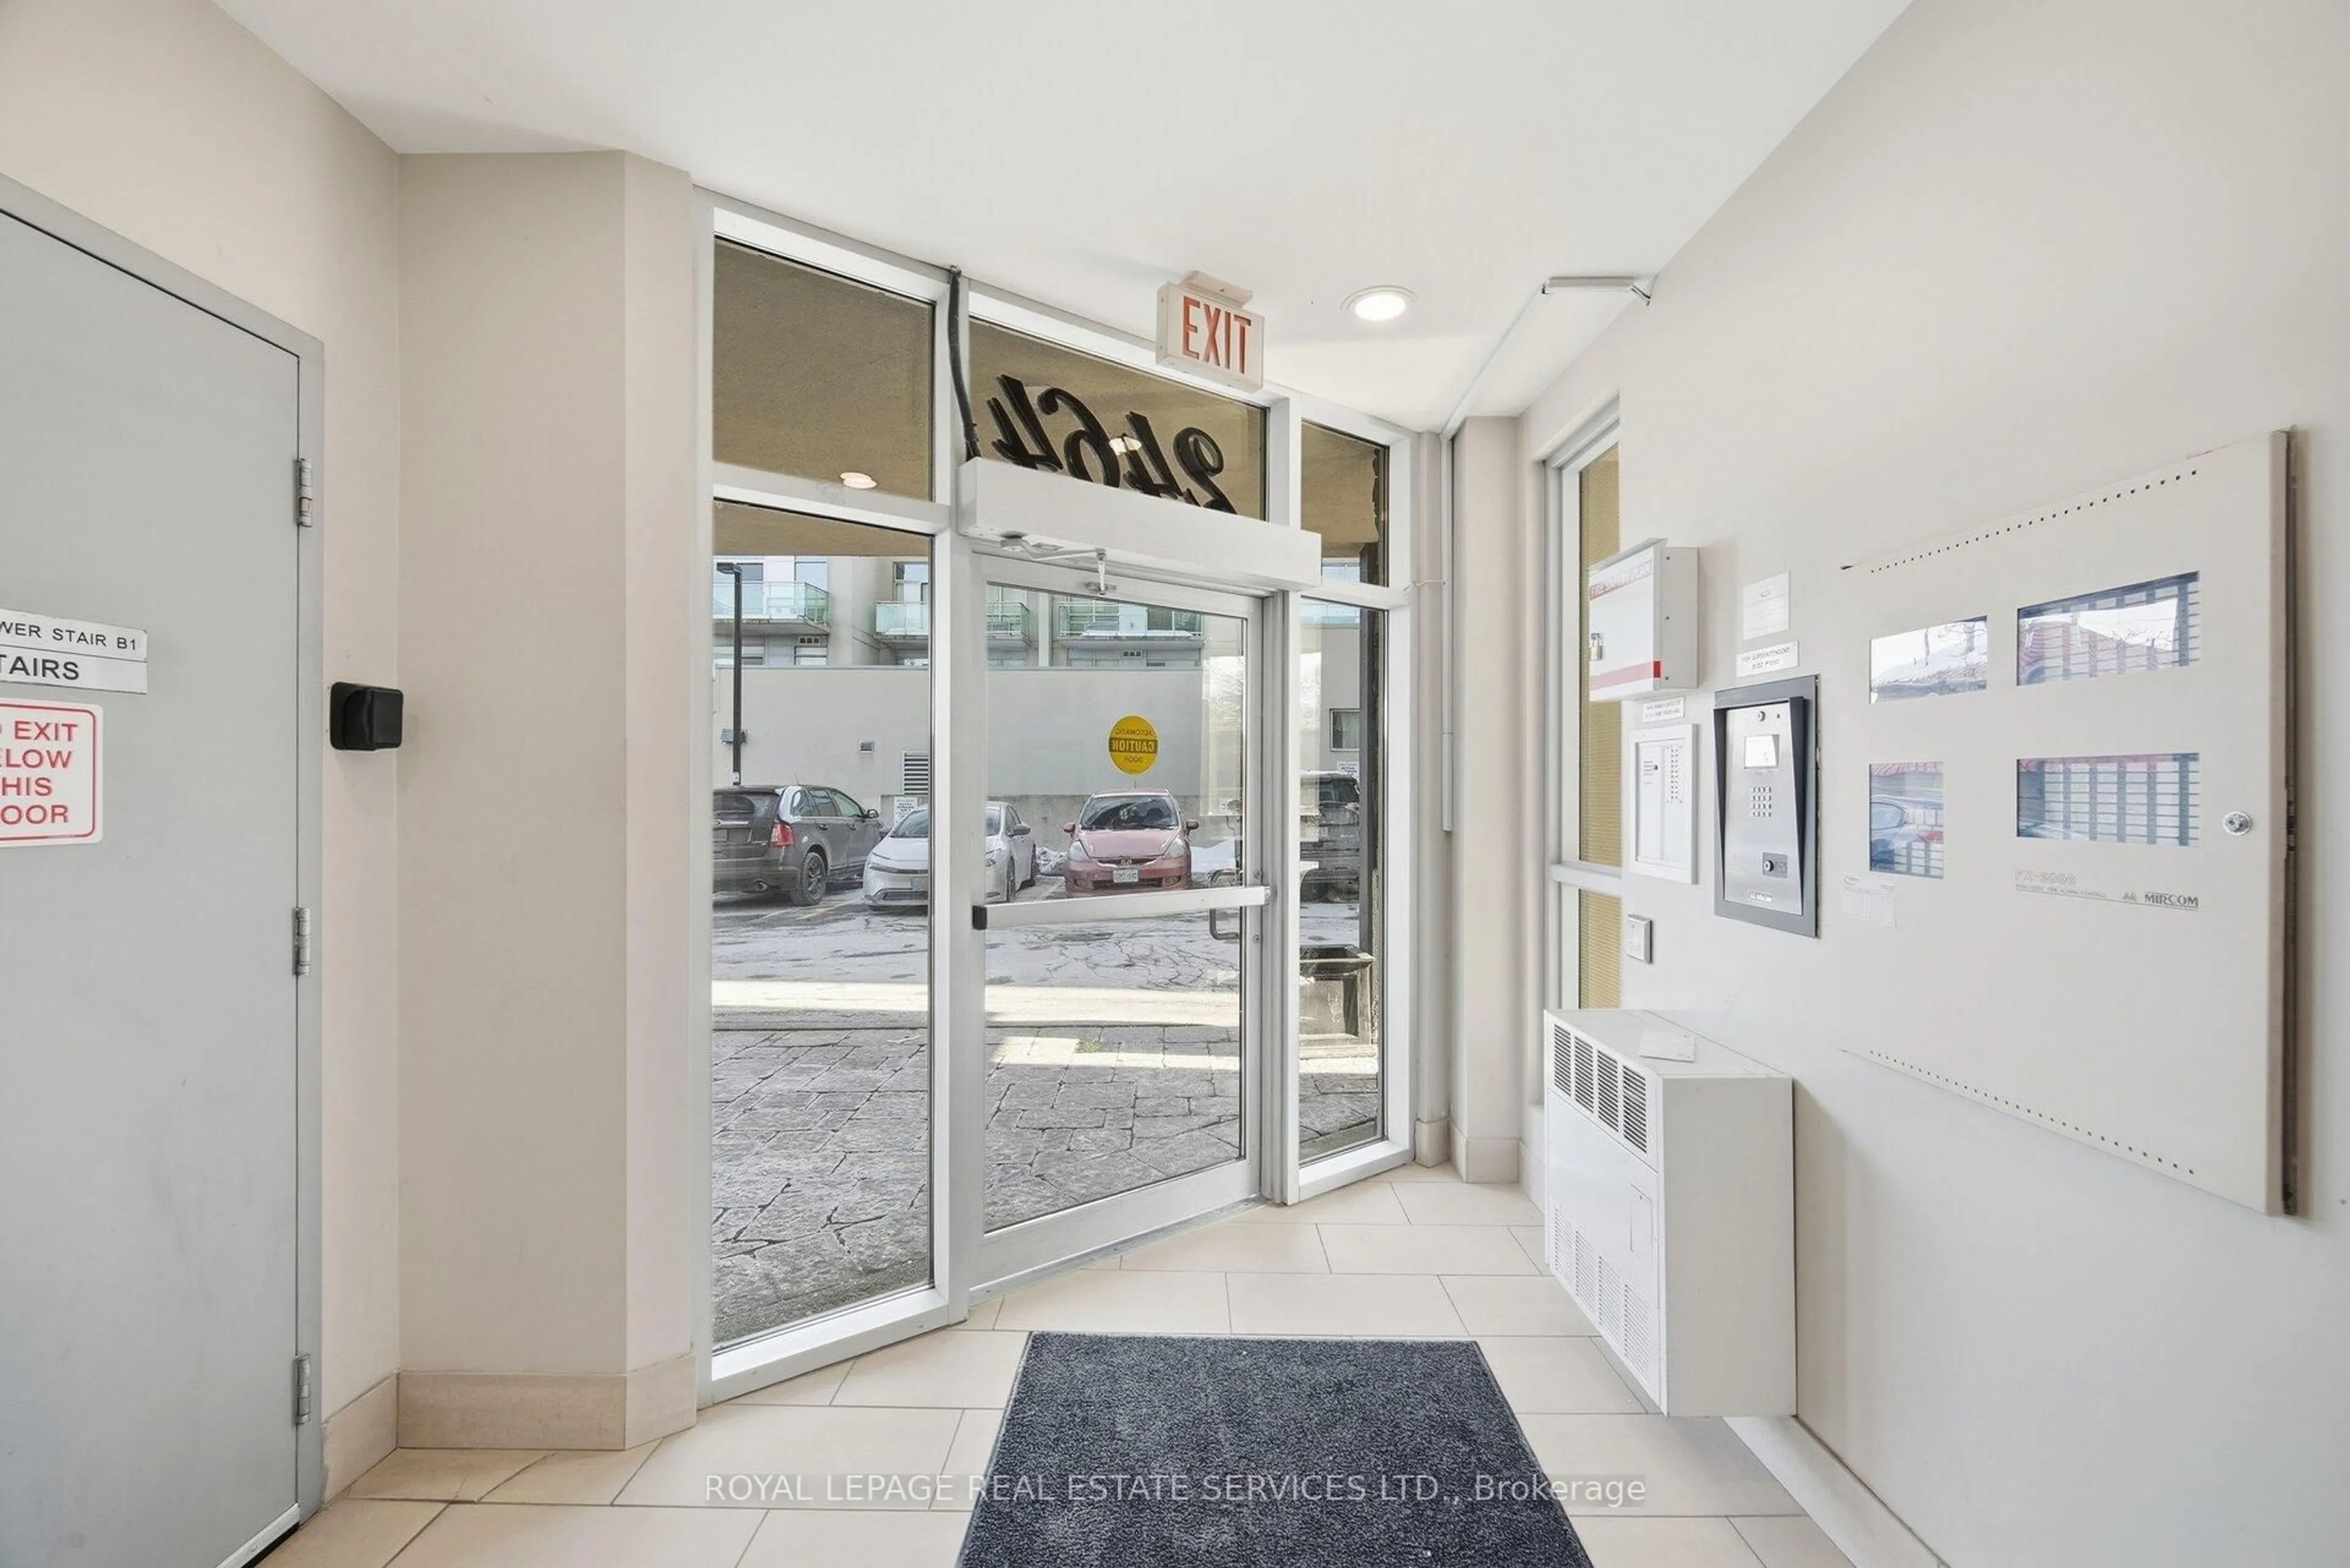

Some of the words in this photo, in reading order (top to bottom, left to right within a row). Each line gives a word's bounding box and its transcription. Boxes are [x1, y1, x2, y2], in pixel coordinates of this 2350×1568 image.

[1182, 294, 1251, 375] EXIT
[53, 628, 106, 648] STAIR
[117, 637, 136, 651] B1
[15, 720, 79, 742] EXIT
[0, 748, 73, 769] LOW
